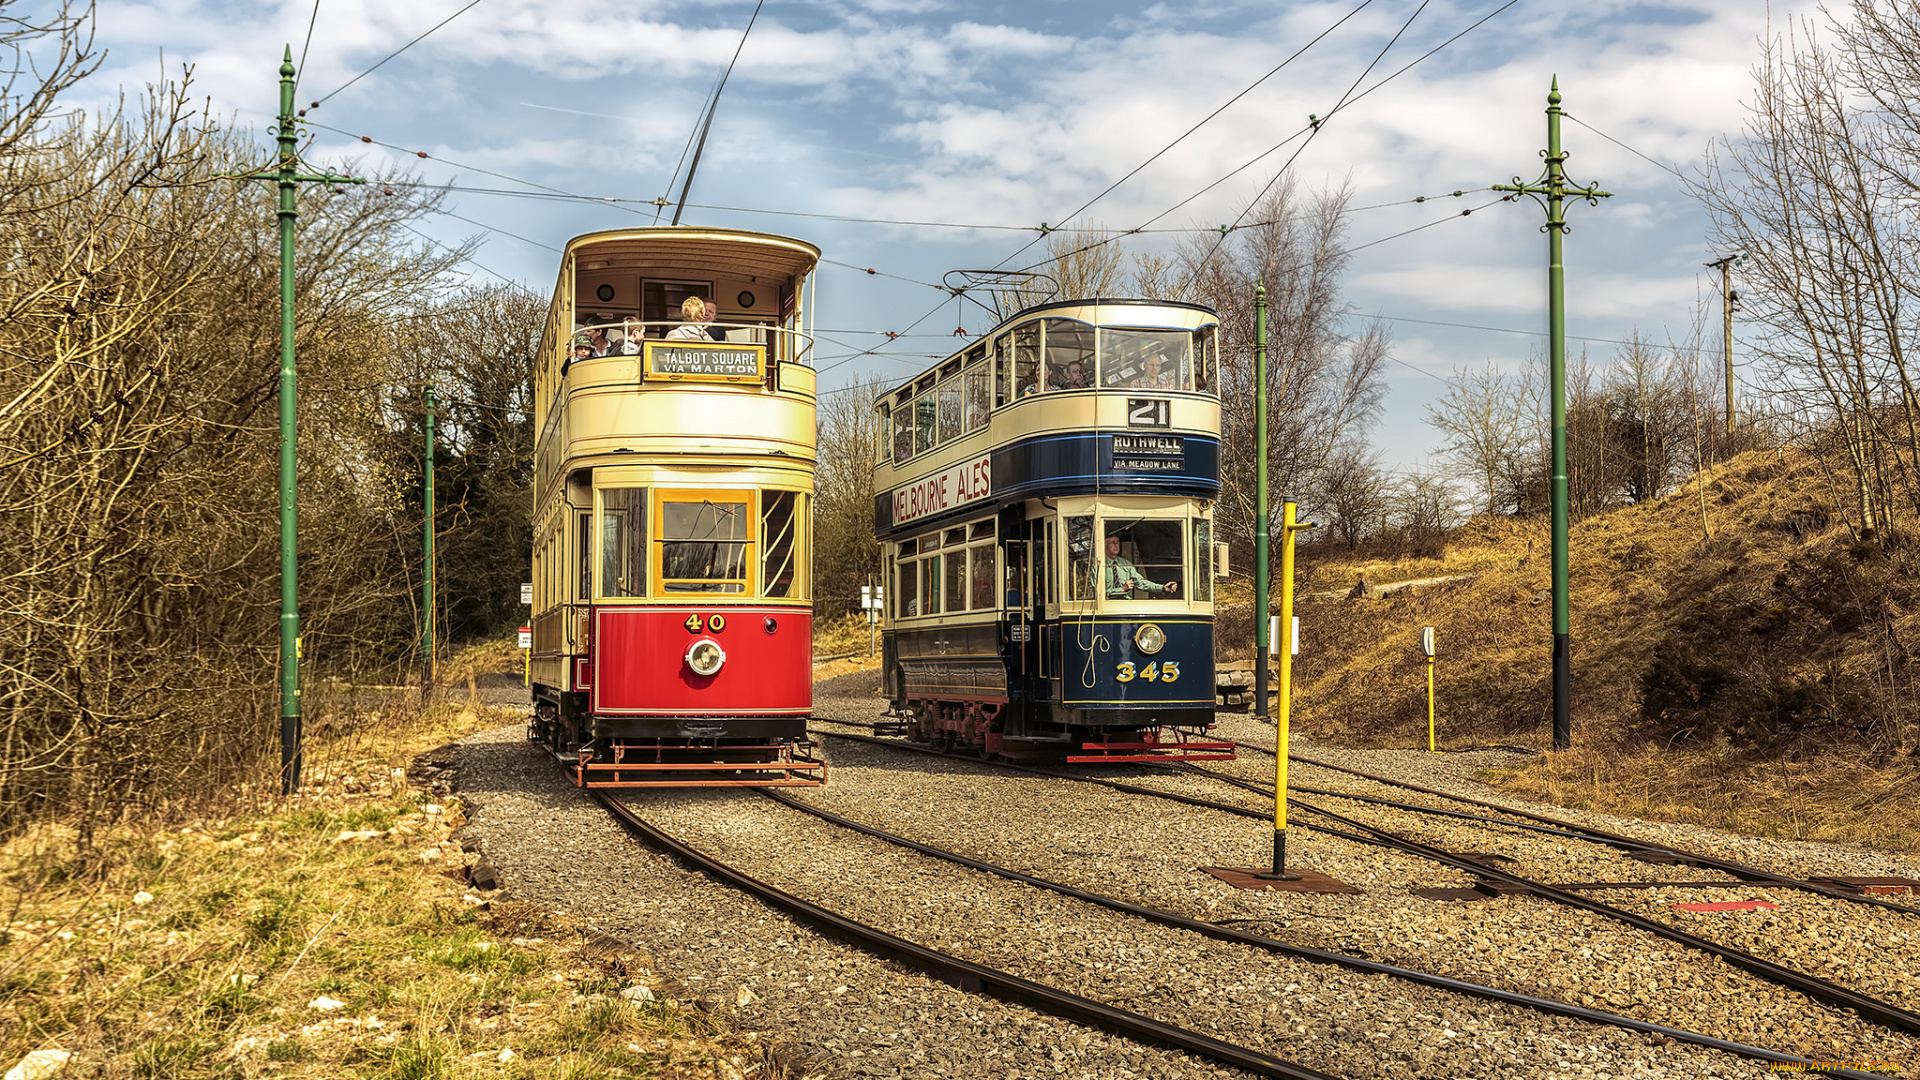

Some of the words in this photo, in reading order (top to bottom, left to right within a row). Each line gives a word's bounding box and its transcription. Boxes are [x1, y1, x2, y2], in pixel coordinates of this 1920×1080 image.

[664, 352, 707, 365] TALBOT
[712, 352, 756, 366] SQUARE
[664, 364, 685, 373] VIA
[691, 364, 757, 374] MARTON
[1129, 399, 1167, 425] 21
[1114, 436, 1181, 449] ROTHWELL
[1114, 460, 1126, 468] VIA
[1128, 460, 1160, 469] MEADOW
[1162, 461, 1180, 469] LANE
[893, 475, 948, 524] MELBOURNE
[956, 458, 990, 504] ALES
[684, 612, 727, 634] 40
[1116, 661, 1180, 683] 345
